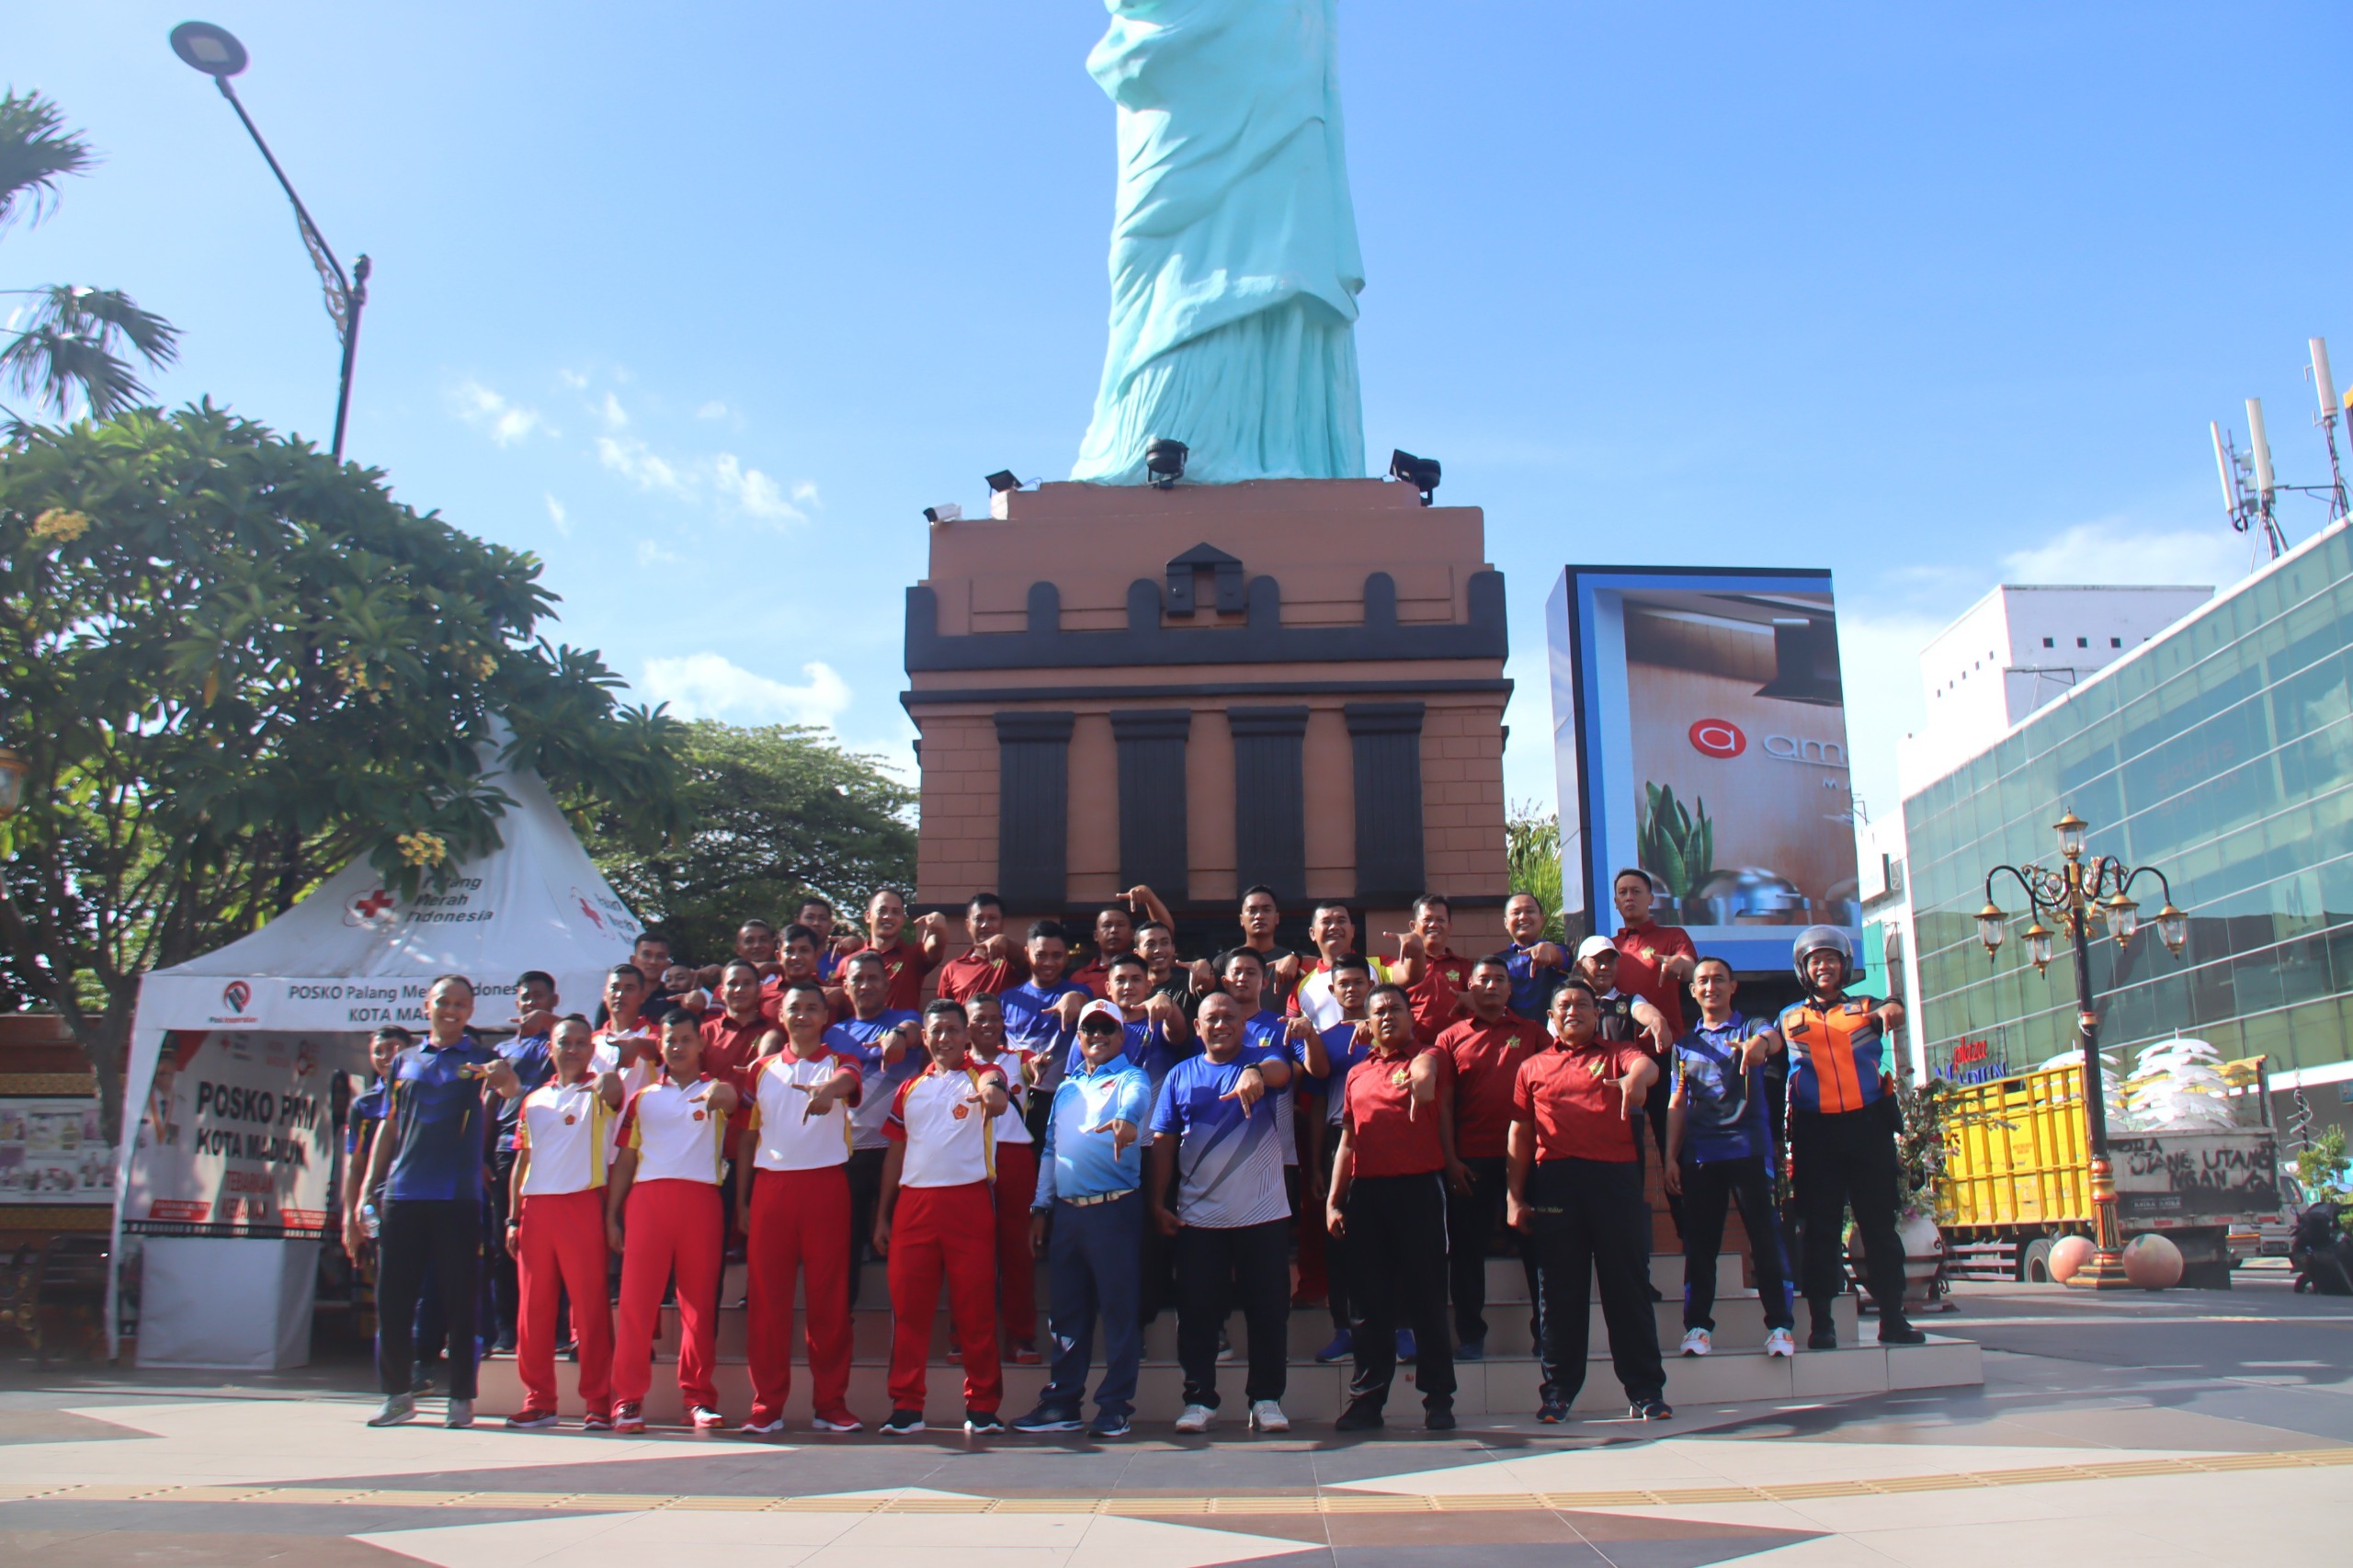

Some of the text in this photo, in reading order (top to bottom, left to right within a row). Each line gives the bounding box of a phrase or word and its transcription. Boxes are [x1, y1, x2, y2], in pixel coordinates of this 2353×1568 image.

[414, 893, 469, 906] Merah
[405, 910, 494, 923] Indonesia
[289, 985, 343, 999] POSKO
[347, 985, 397, 1003] Palang
[348, 1007, 392, 1021] KOTA
[1954, 1036, 1987, 1073] plaza
[196, 1081, 317, 1131] POSKO PMI
[196, 1128, 243, 1158] KOTA
